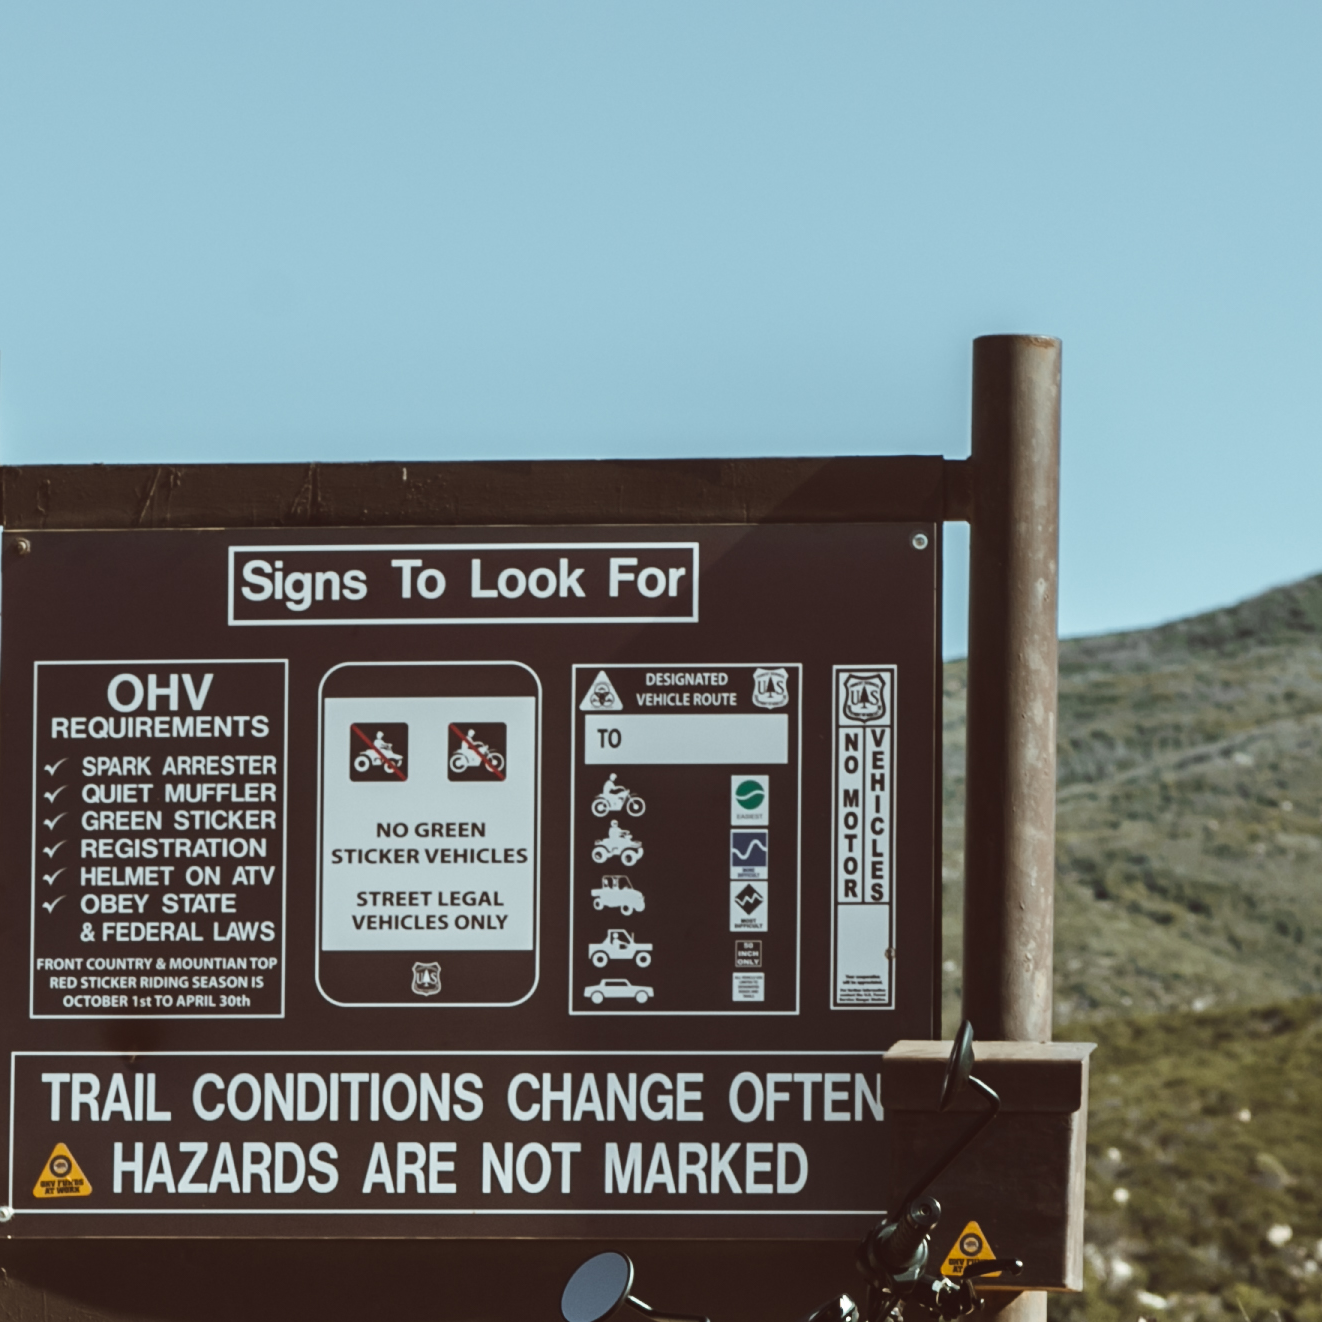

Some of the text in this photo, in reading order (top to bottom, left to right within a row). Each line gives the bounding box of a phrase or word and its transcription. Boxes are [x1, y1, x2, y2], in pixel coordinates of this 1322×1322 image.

[241, 557, 686, 612] Signs To Look For
[645, 672, 729, 686] DESIGNATED
[107, 673, 214, 713] OHV
[635, 692, 737, 707] VEHICLE ROUTE
[51, 715, 270, 739] REQUIREMENTS
[596, 728, 622, 749] TO
[81, 754, 277, 777] SPARK ARRESTER
[81, 782, 277, 804] QUIET MUFFLER
[81, 809, 277, 831] GREEN STICKER
[843, 732, 860, 899] NO MOTOR
[869, 728, 887, 902] VEHICLES
[376, 822, 486, 838] NO GREEN
[80, 837, 267, 859] REGISTRATION
[331, 847, 528, 865] STICKER VEHICLES
[80, 865, 276, 887] HELMET ON ATV
[80, 893, 237, 915] OBEY STATE
[356, 890, 505, 907] STREET LEGAL
[79, 920, 276, 942] & FEDERAL LAWS
[351, 914, 508, 931] VEHICLES ONLY
[36, 956, 278, 971] FRONT COUNTRY & MOUNTIAN TOP
[49, 975, 265, 990] RED STICKER RIDING SEASON IS
[62, 994, 251, 1008] OCTOBER 1st TO APRIL 30th
[41, 1072, 884, 1122] TRAIL CONDITIONS CHANGE OFTEN
[112, 1141, 809, 1194] HAZARDS ARE NOT MARKED
